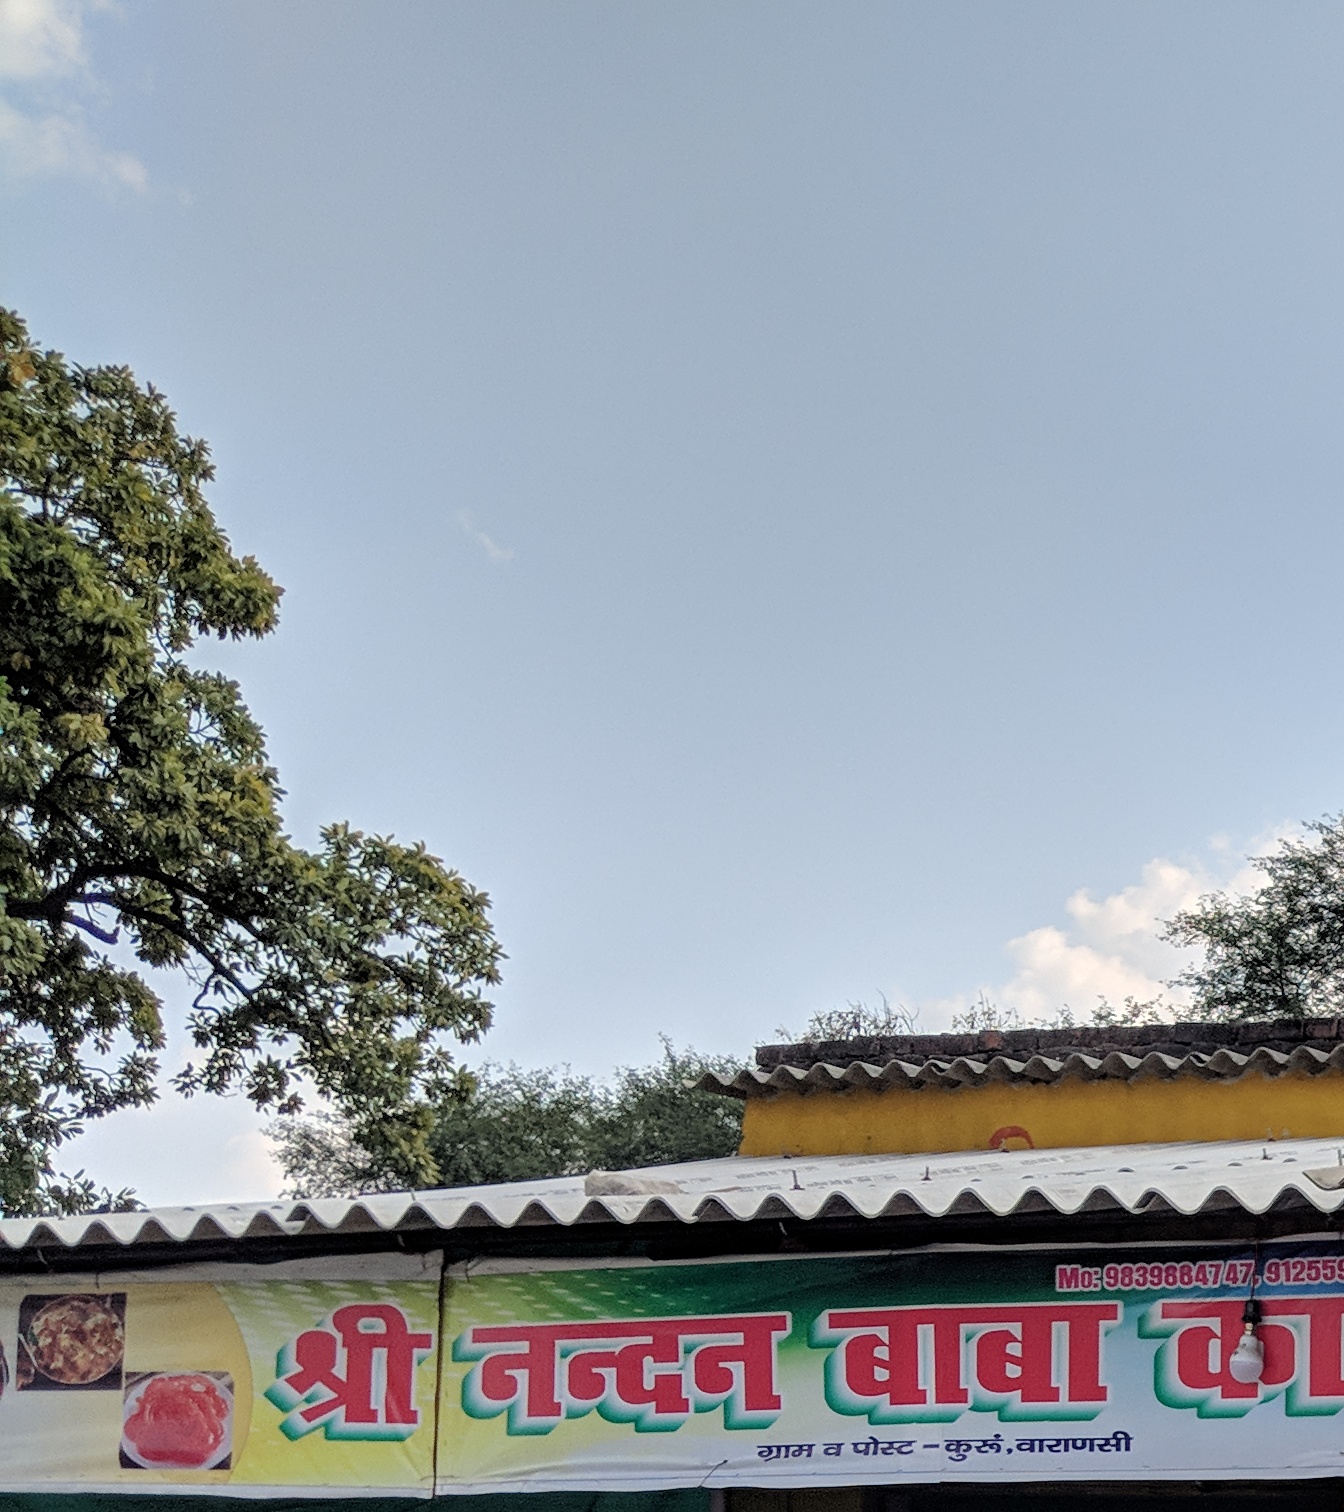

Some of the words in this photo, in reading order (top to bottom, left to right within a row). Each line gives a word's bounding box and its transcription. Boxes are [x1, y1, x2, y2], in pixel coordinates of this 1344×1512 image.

[1056, 1264, 1100, 1290] Mo:
[275, 1303, 432, 1433] श्री
[465, 1313, 790, 1426] नन्दन
[820, 1302, 1121, 1412] बाबा
[757, 1443, 815, 1462] ग्राम
[823, 1443, 843, 1456] व
[850, 1436, 917, 1456] पोस्ट
